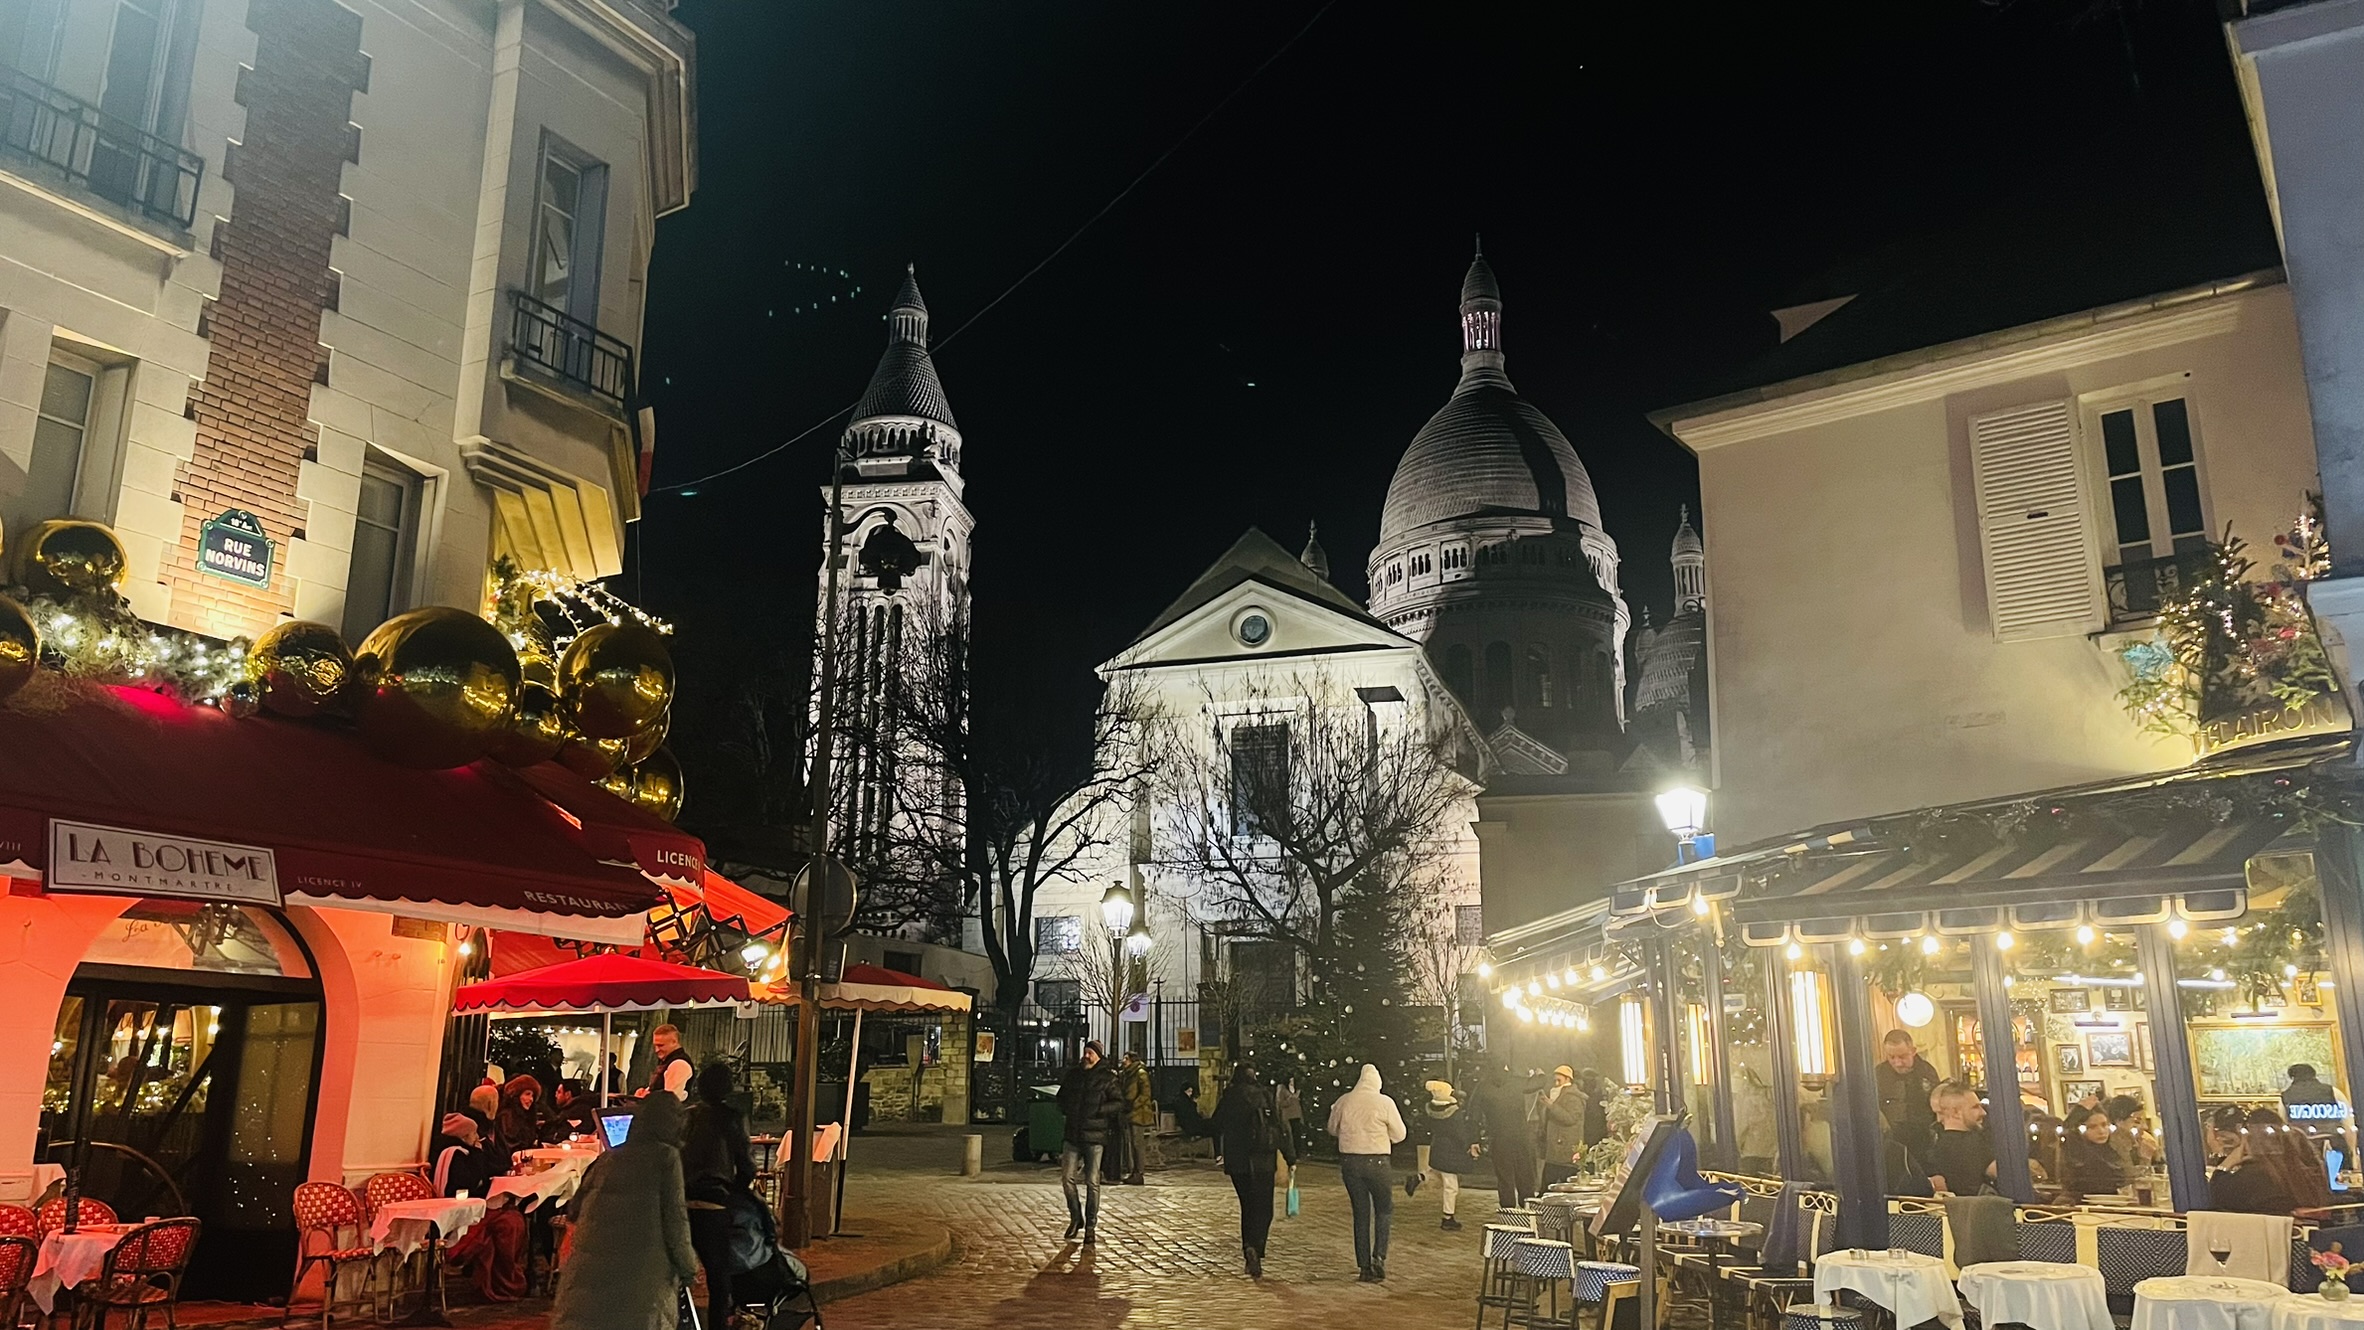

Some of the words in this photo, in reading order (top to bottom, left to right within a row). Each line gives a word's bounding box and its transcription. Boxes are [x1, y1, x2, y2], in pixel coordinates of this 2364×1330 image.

[224, 538, 252, 557] RUE
[205, 549, 265, 577] NORVINS
[69, 833, 111, 865] LA
[132, 841, 266, 882] BOHEME
[657, 849, 698, 871] LICENCE
[298, 876, 345, 888] LICENCE
[352, 881, 362, 889] IV
